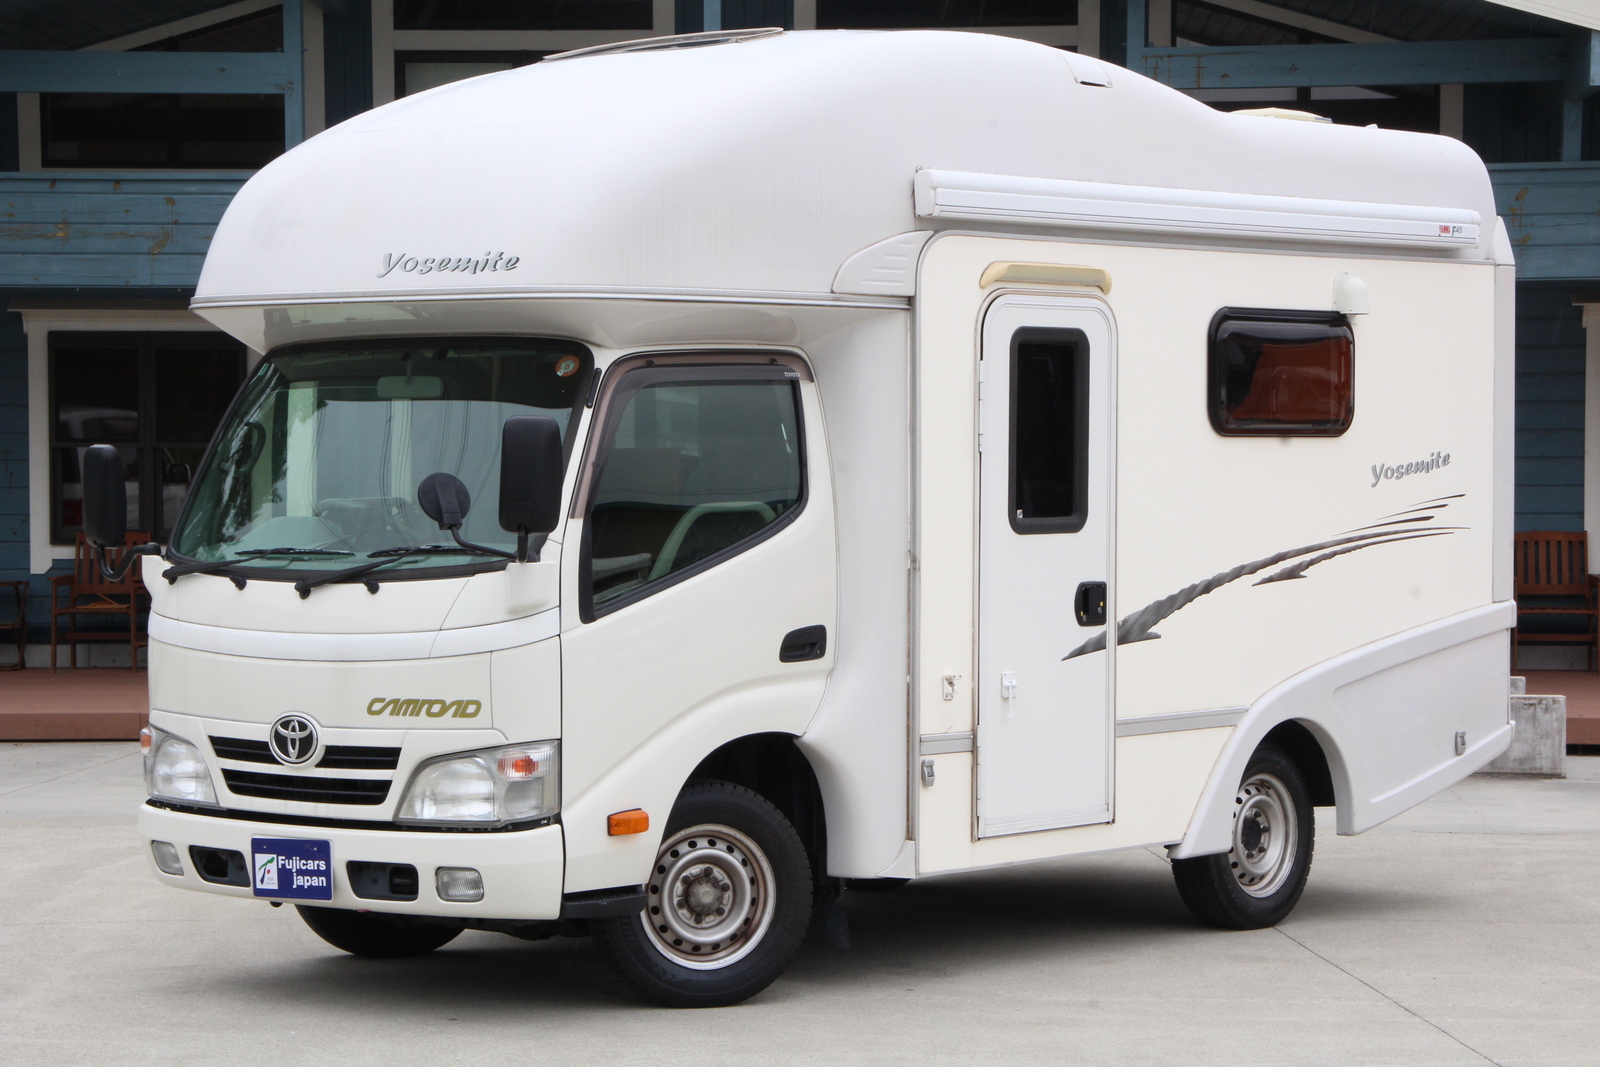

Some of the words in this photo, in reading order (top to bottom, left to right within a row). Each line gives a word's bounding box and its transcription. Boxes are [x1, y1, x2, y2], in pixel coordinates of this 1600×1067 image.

[375, 250, 521, 279] Yosemite
[1370, 450, 1451, 488] Yosemite
[366, 697, 482, 719] CAMROAD
[277, 855, 327, 873] Fujicars
[292, 872, 327, 889] japan
